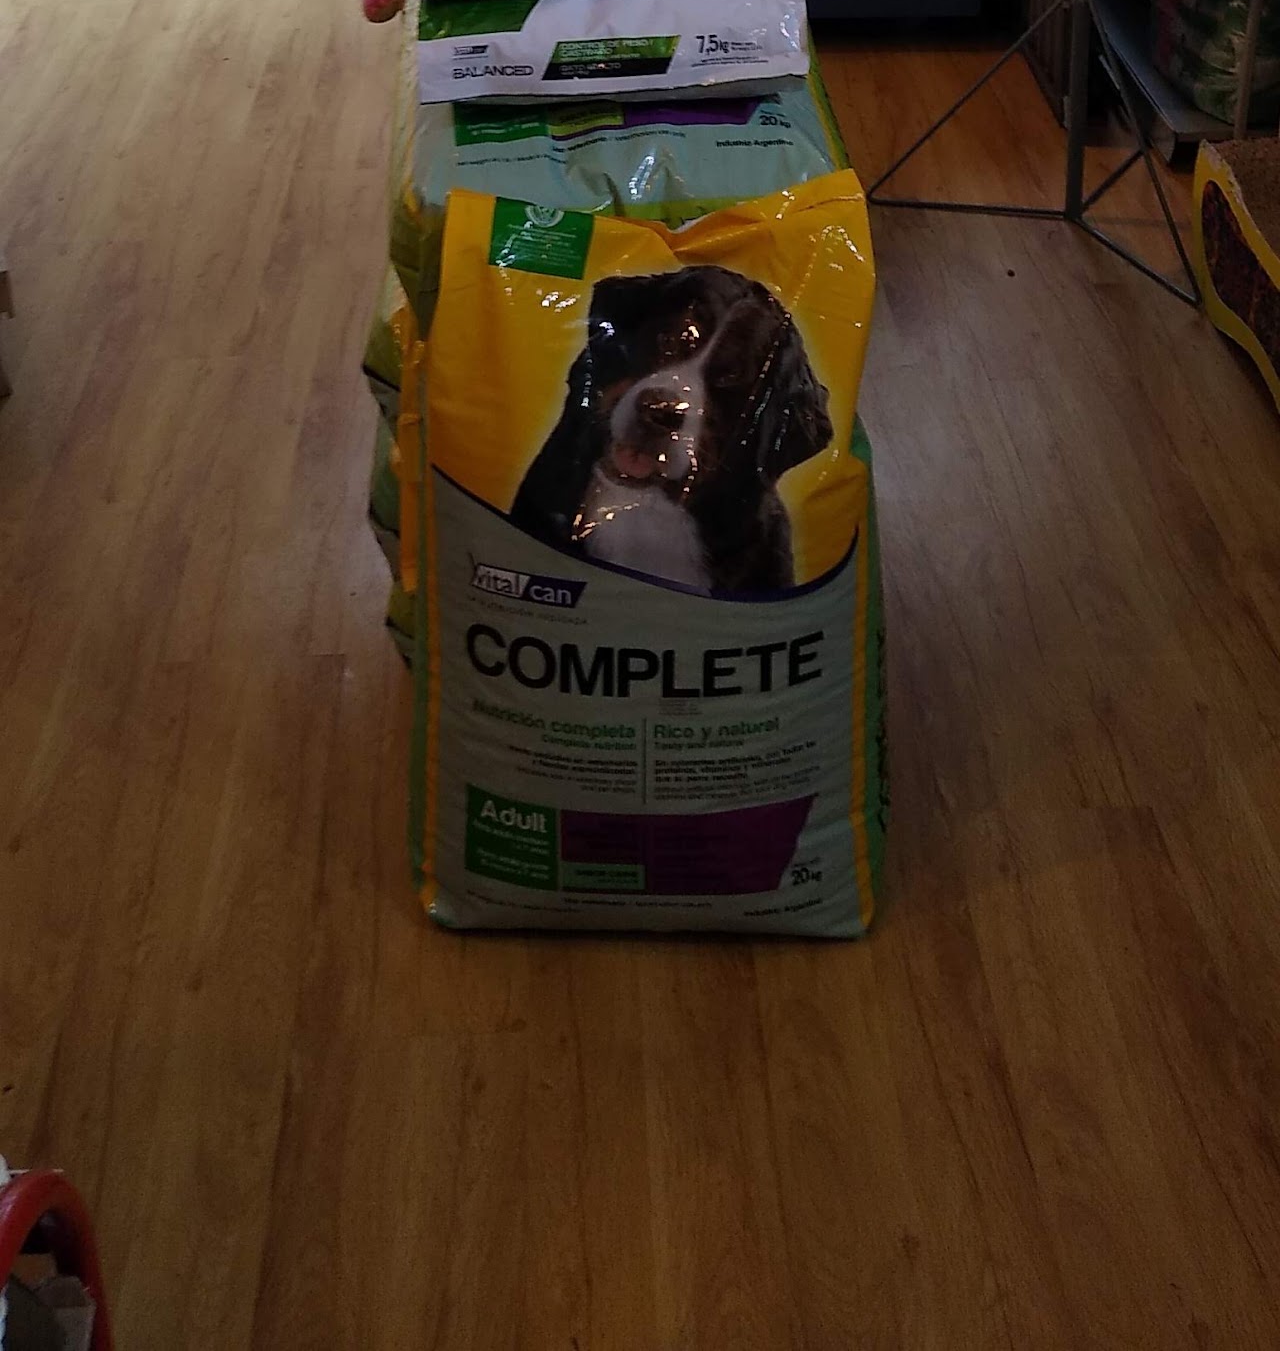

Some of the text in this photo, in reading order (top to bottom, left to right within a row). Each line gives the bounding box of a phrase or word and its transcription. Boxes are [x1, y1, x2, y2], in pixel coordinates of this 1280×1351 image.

[452, 65, 534, 79] BALANCED
[759, 115, 777, 127] 20
[466, 623, 824, 698] COMPLETE
[551, 721, 637, 739] completa
[654, 717, 780, 740] Rico y natural
[481, 800, 548, 833] Adult
